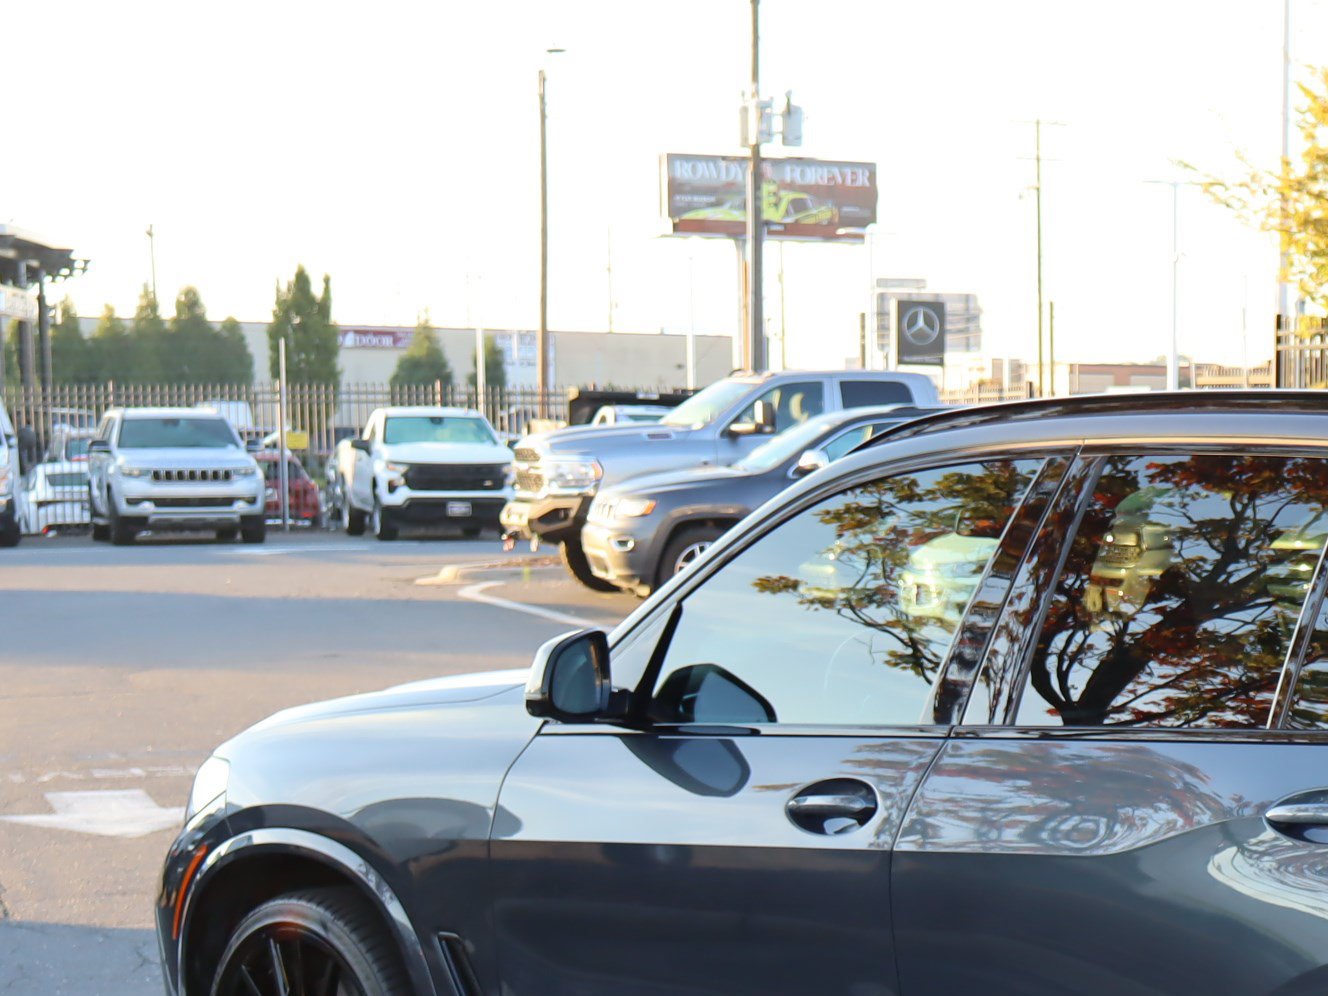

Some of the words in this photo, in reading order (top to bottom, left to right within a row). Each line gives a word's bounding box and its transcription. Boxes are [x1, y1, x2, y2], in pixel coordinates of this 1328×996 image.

[674, 159, 746, 182] ROWDY
[784, 163, 870, 186] FOREVER
[355, 334, 394, 346] DOOR
